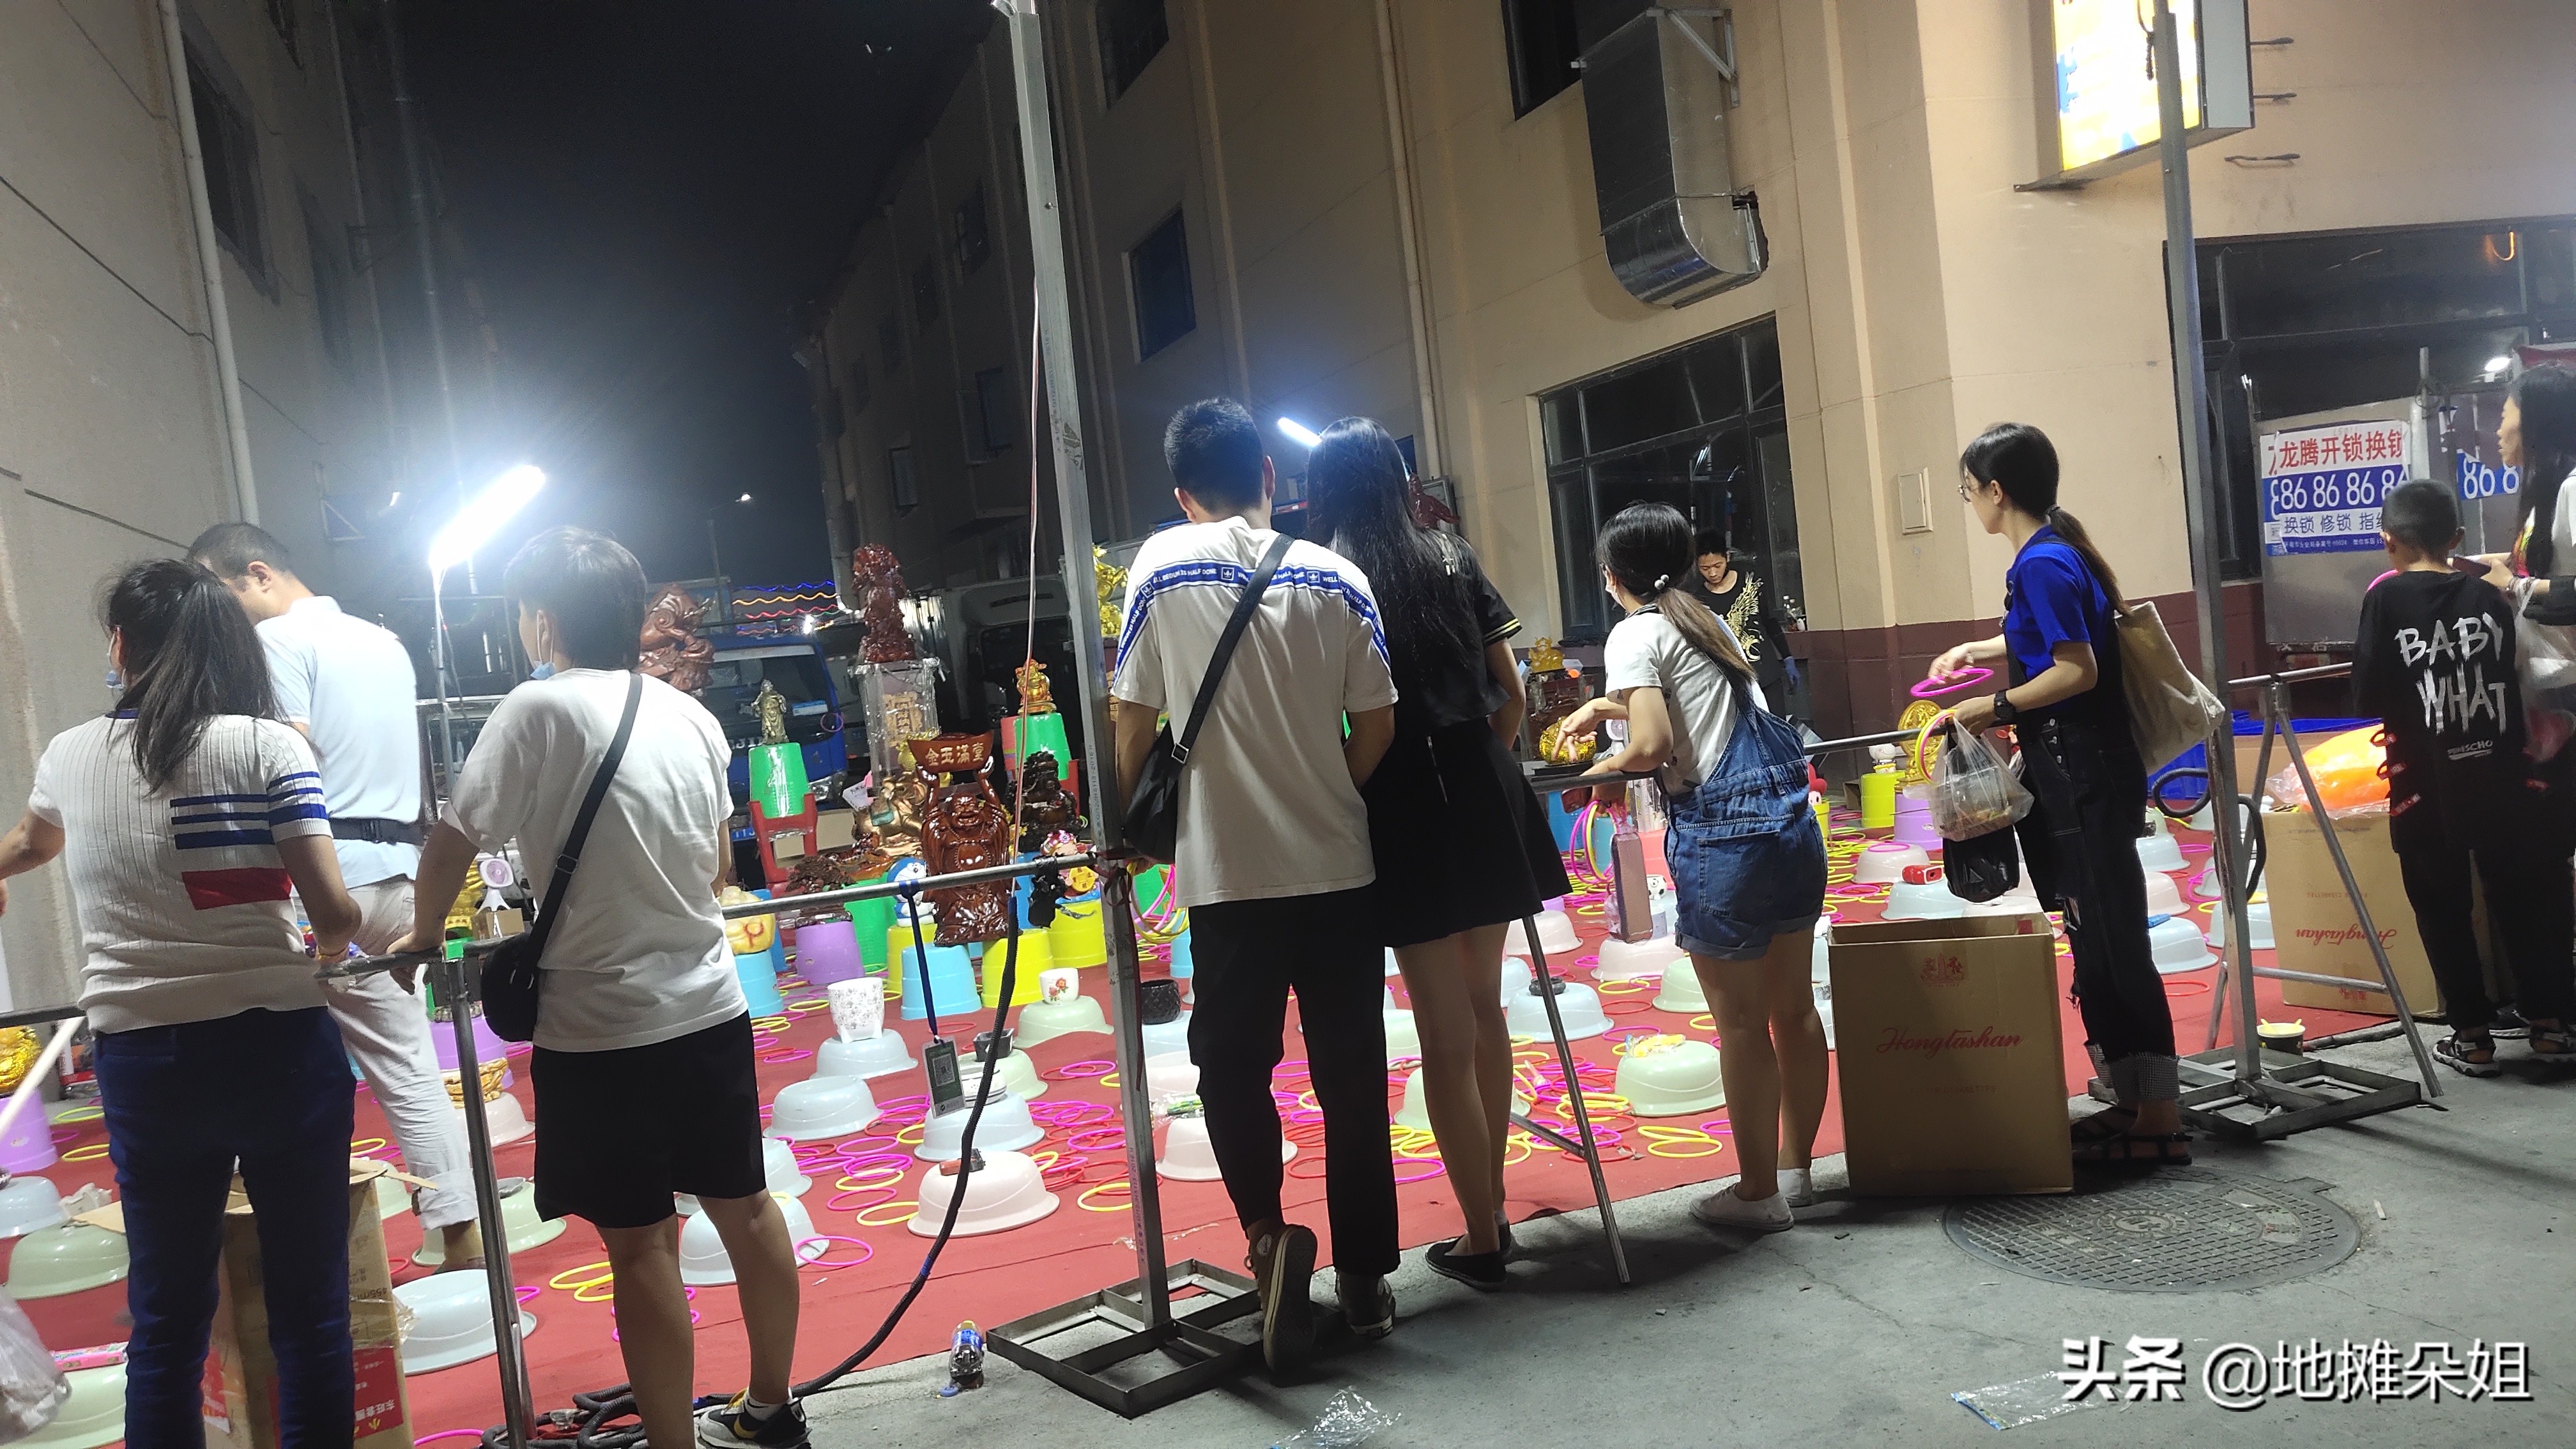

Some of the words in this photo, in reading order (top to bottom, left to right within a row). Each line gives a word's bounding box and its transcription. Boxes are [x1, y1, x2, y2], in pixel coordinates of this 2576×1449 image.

[2280, 477, 2308, 510] 86
[2313, 474, 2340, 508] 86
[2346, 471, 2375, 505] 86
[2464, 456, 2496, 499] 86
[2284, 516, 2315, 535] 换锁
[2320, 513, 2352, 533] 修锁
[1374, 631, 1384, 647] WELL
[2394, 611, 2504, 668] BABY
[2415, 662, 2507, 736] WHAT
[925, 742, 984, 767] 金玉满堂
[1876, 1026, 2023, 1059] Hongtashan
